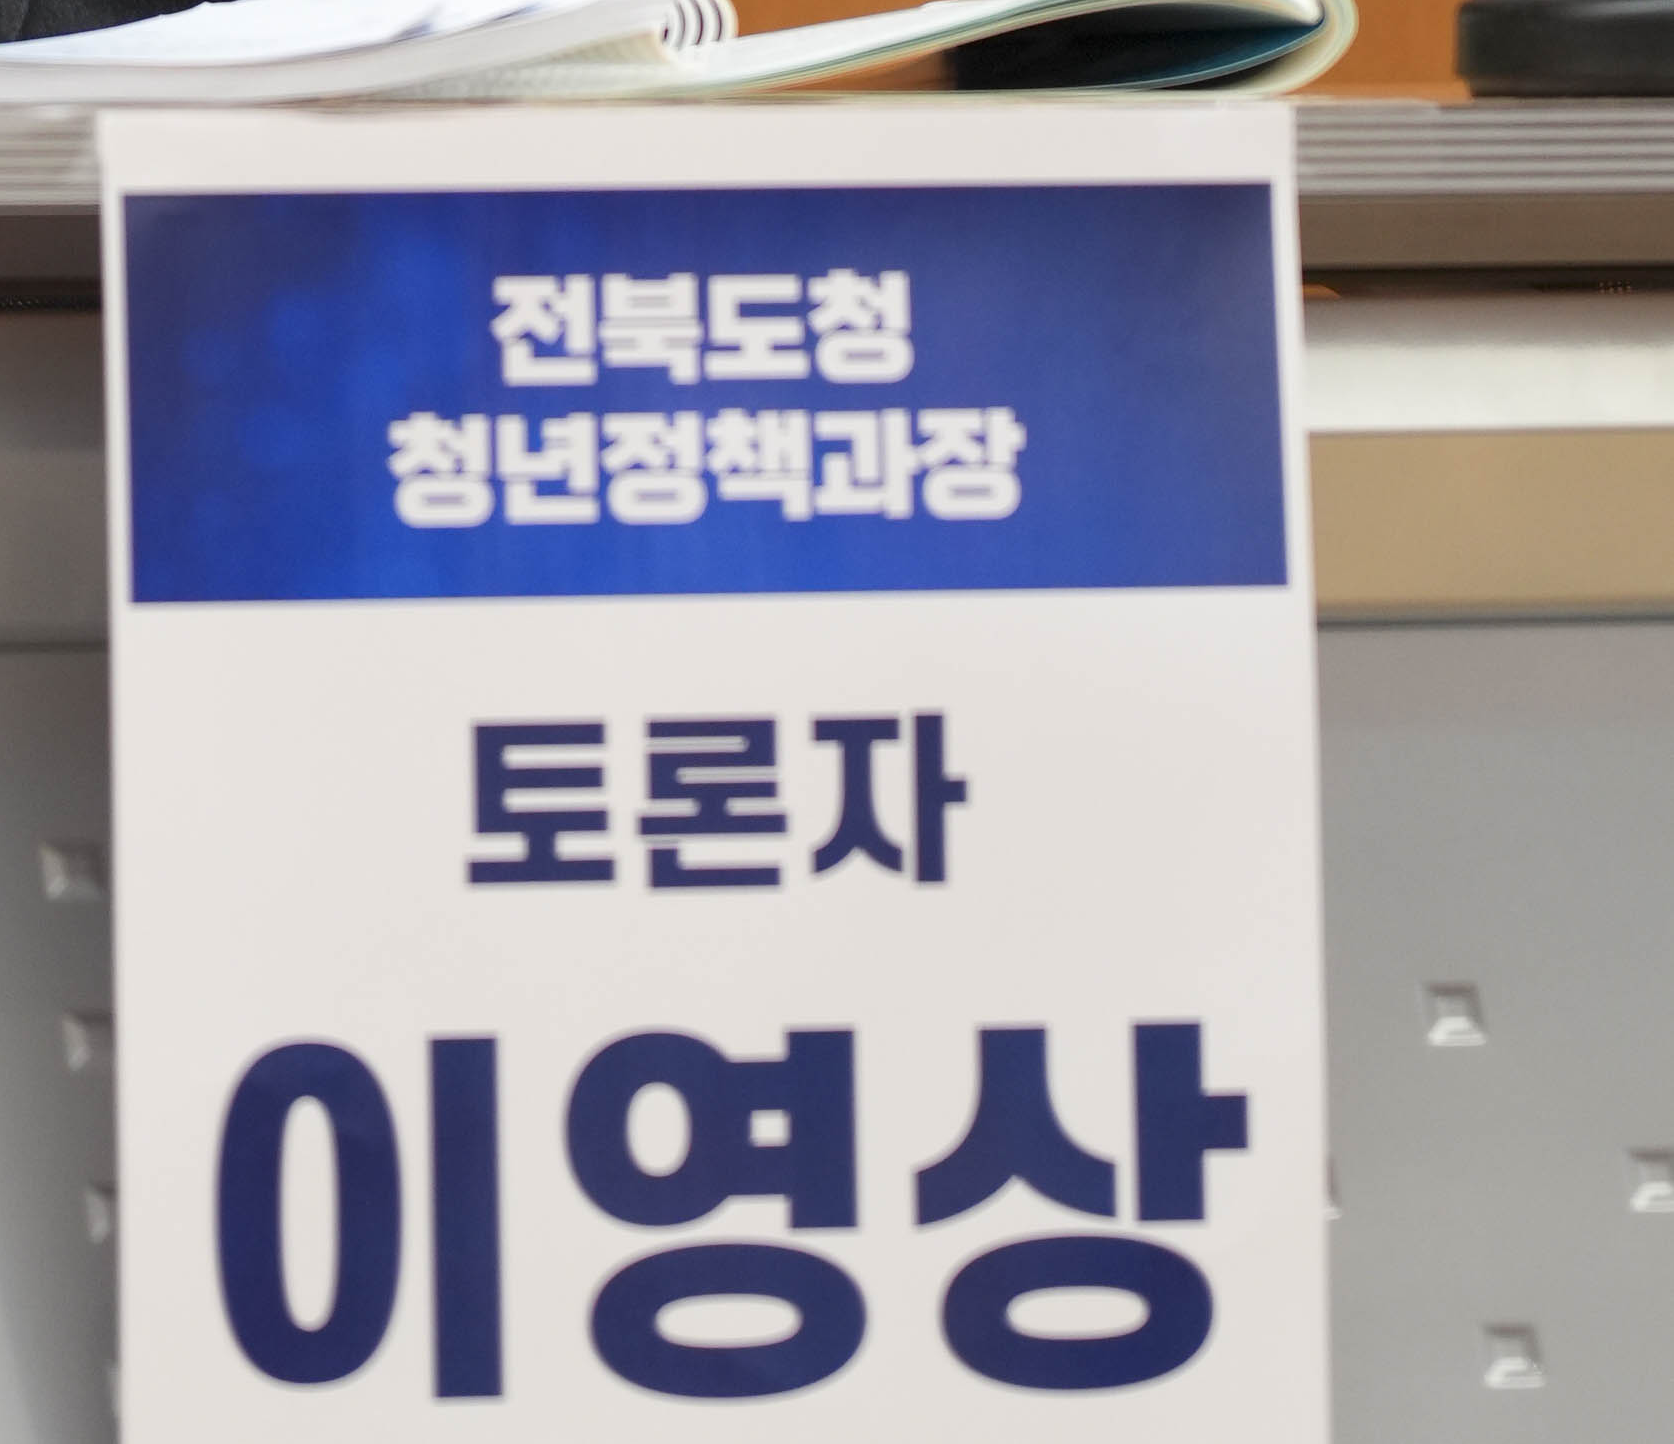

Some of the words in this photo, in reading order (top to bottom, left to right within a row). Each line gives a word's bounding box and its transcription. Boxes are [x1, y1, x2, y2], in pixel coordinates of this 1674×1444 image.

[490, 267, 915, 387] 전북도청
[388, 406, 1027, 529] 청년정책과장
[466, 712, 969, 891] 토론자
[213, 1021, 1250, 1401] 이영상
